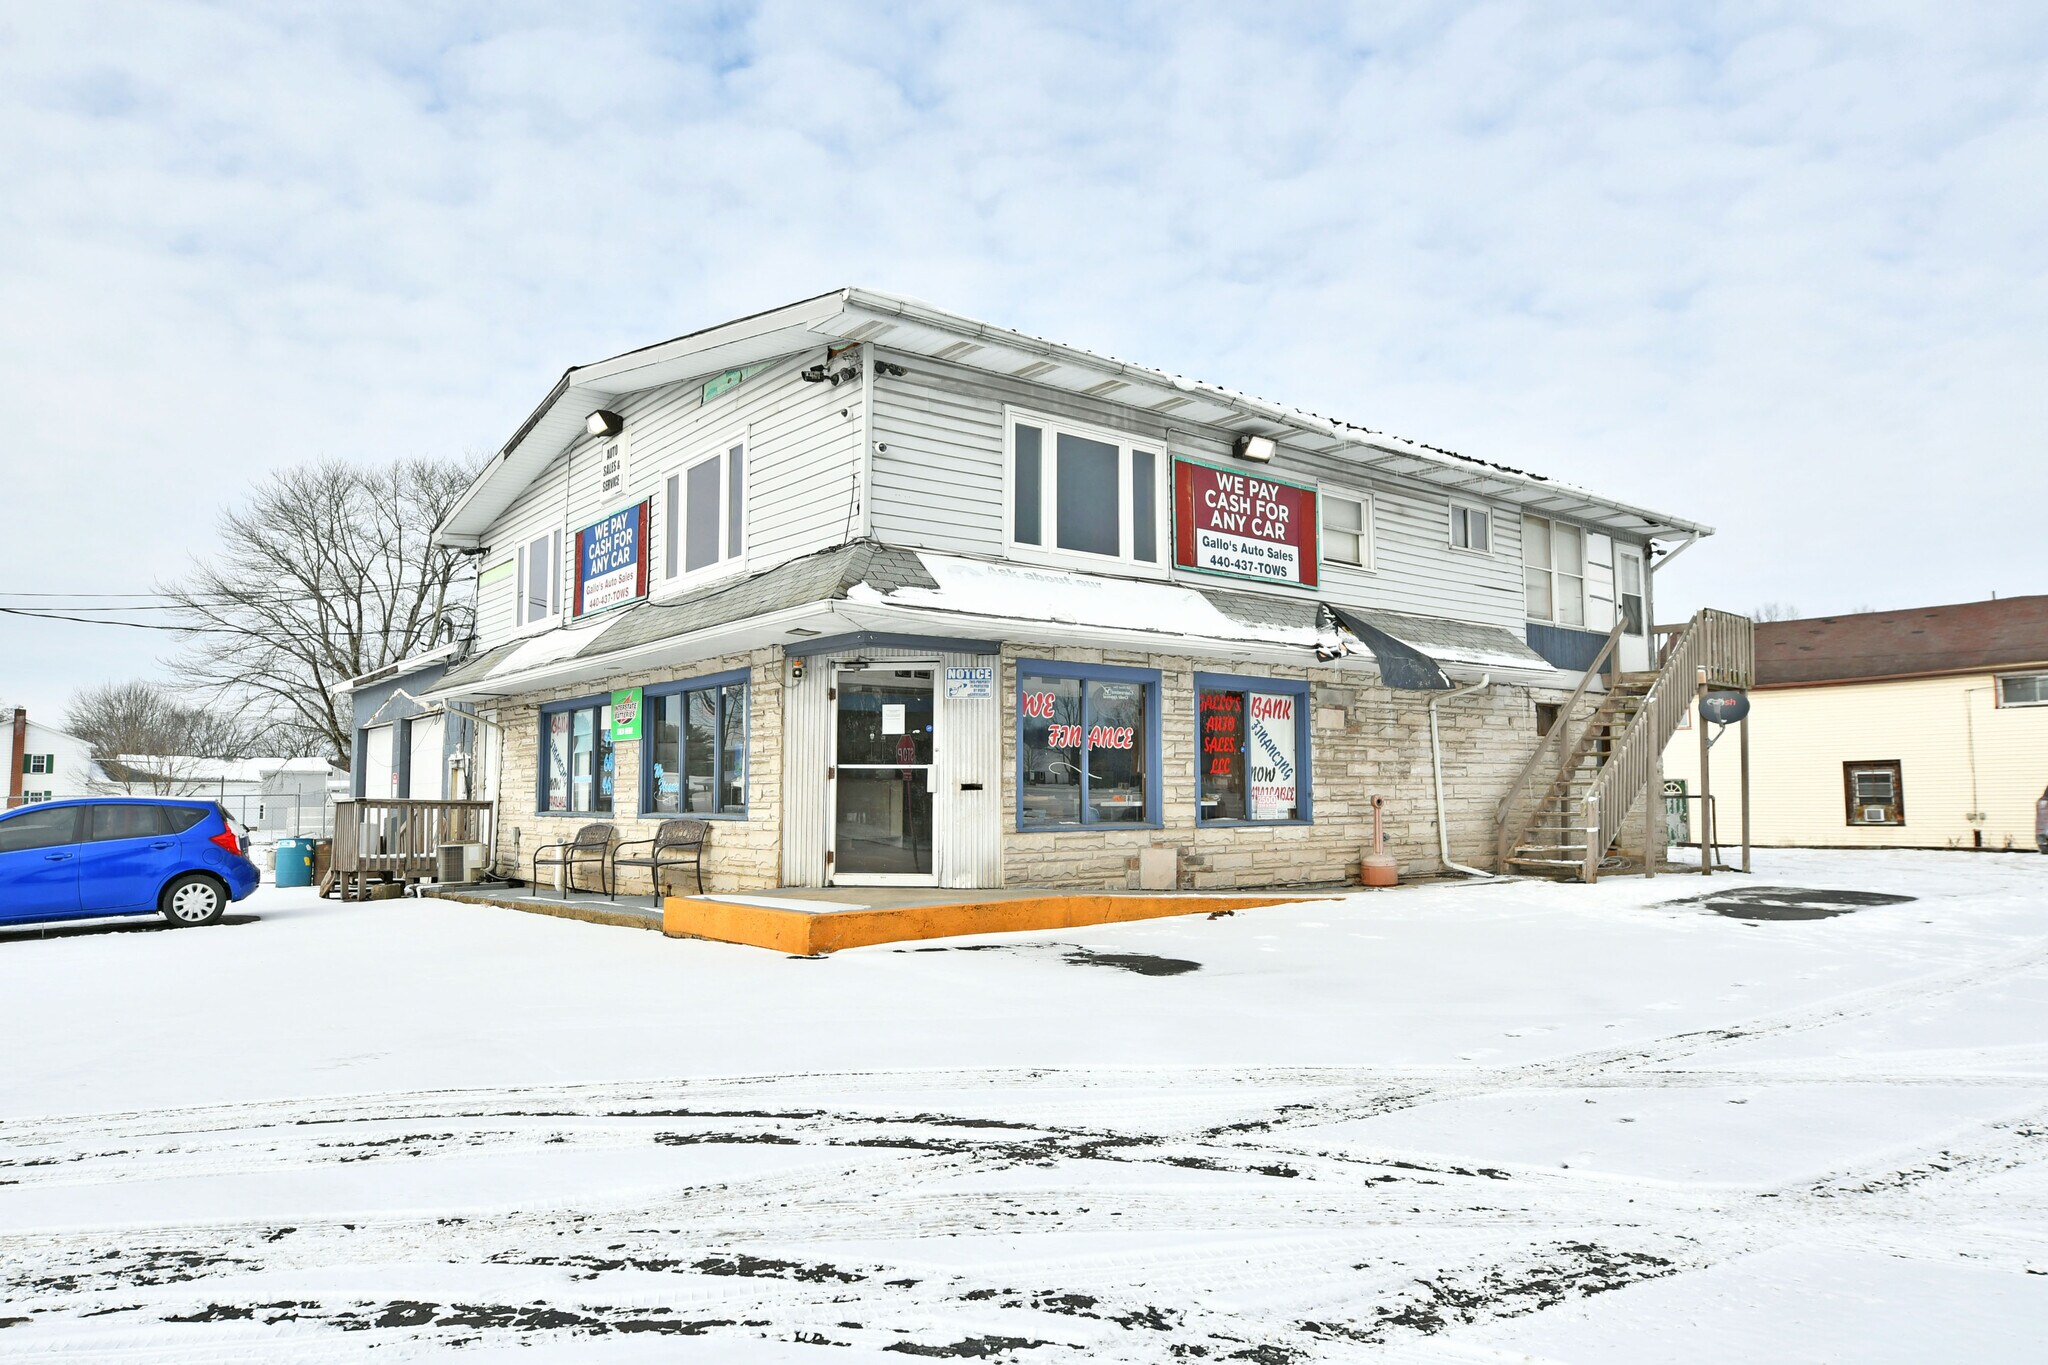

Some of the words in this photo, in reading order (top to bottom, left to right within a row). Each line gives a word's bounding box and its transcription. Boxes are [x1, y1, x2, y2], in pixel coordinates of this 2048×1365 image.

[607, 444, 618, 460] AUTO
[603, 460, 616, 477] SALES
[602, 474, 619, 492] SERVICE
[1215, 471, 1244, 495] WE
[1250, 480, 1279, 501] PAY
[1204, 489, 1250, 515] CASH
[1256, 500, 1289, 523] FOR
[594, 521, 609, 541] WE
[611, 512, 628, 534] PAY
[1210, 510, 1246, 533] ANY
[1251, 518, 1285, 540] CAR
[589, 536, 612, 560] CASH
[614, 528, 633, 550] FOR
[1202, 535, 1238, 553] Gallo's
[1241, 543, 1264, 558] Auto
[1267, 547, 1294, 562] Sales
[590, 554, 609, 576] ANY
[611, 546, 630, 568] CAR
[1210, 555, 1287, 577] 440-437-TOWS
[586, 583, 604, 595] Gallo's
[604, 577, 617, 588] Auto
[618, 572, 634, 583] Sales
[986, 565, 1017, 580] Ask
[1024, 571, 1070, 587] about
[589, 587, 630, 608] 440-437-TOWS
[947, 668, 991, 679] NOTICE
[1023, 690, 1056, 719] WE
[1251, 696, 1292, 721] BANK
[1206, 716, 1236, 733] AUTO
[1048, 724, 1134, 751] FINANCE
[1251, 719, 1293, 781] FINANCING
[1210, 758, 1231, 774] LLC
[1251, 766, 1276, 782] NOW
[1251, 786, 1295, 801] AVAILABLE
